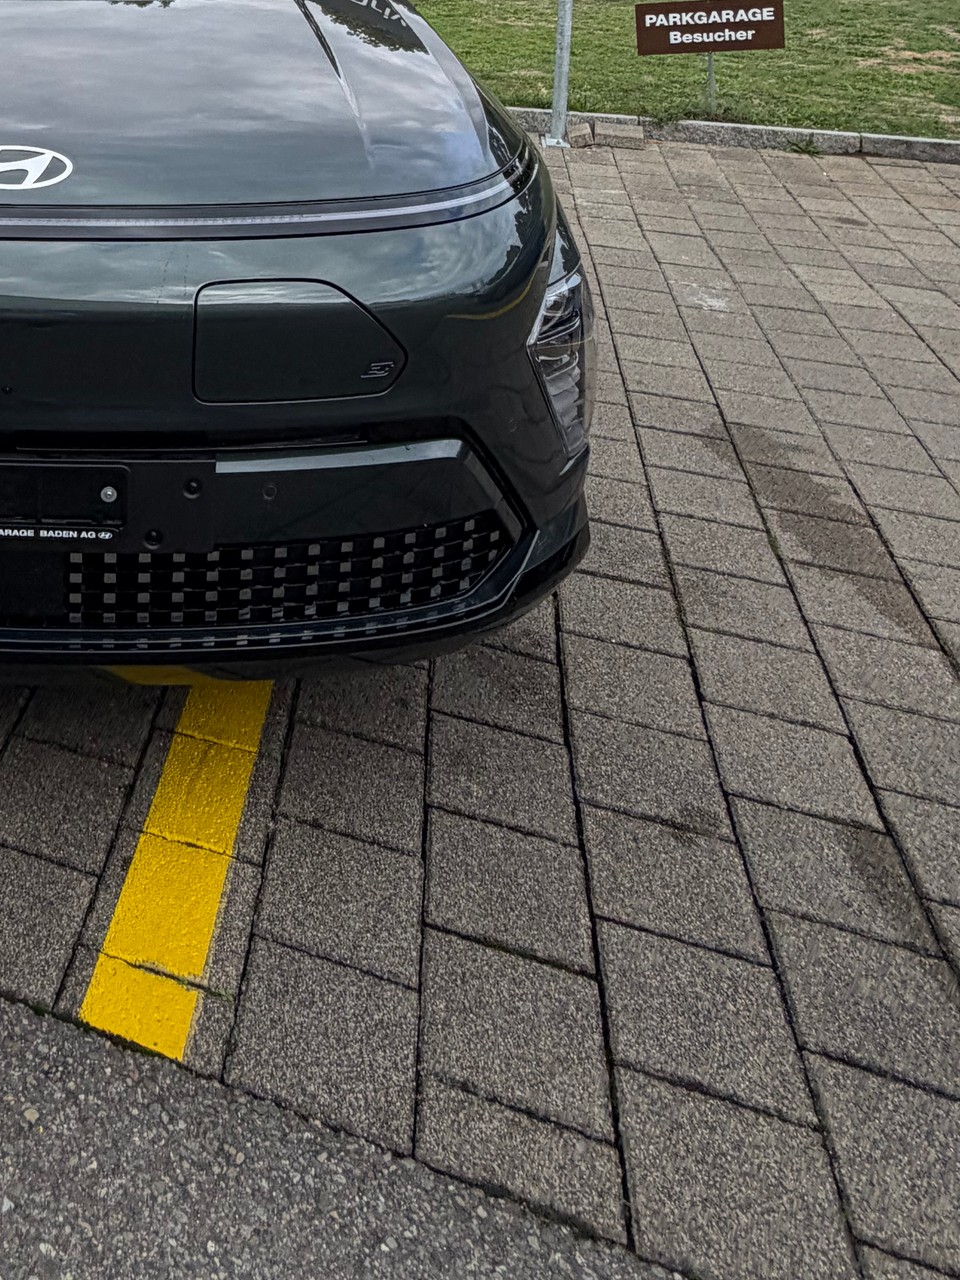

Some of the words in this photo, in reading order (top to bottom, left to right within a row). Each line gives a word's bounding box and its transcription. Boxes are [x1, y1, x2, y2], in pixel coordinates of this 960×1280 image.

[644, 7, 775, 27] PARKGARAGE
[669, 28, 756, 44] Besucher
[39, 529, 77, 538] BADEN
[80, 531, 96, 539] AG
